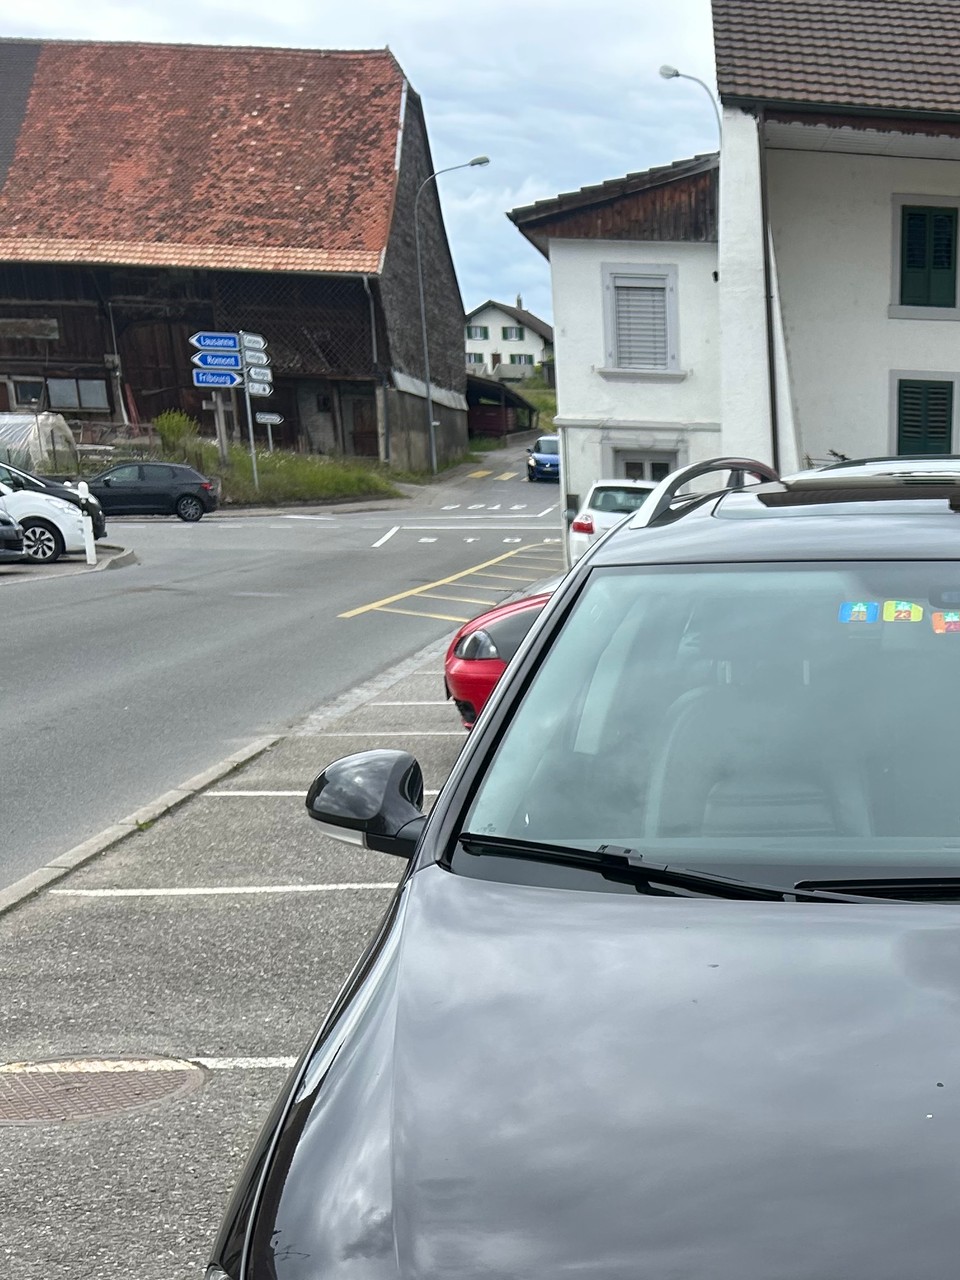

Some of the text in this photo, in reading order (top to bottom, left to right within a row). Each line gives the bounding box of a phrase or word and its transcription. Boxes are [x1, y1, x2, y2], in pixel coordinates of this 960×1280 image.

[200, 336, 235, 347] Lausanne
[206, 355, 236, 365] Romont
[199, 373, 231, 385] Fribourg
[895, 610, 912, 620] 23
